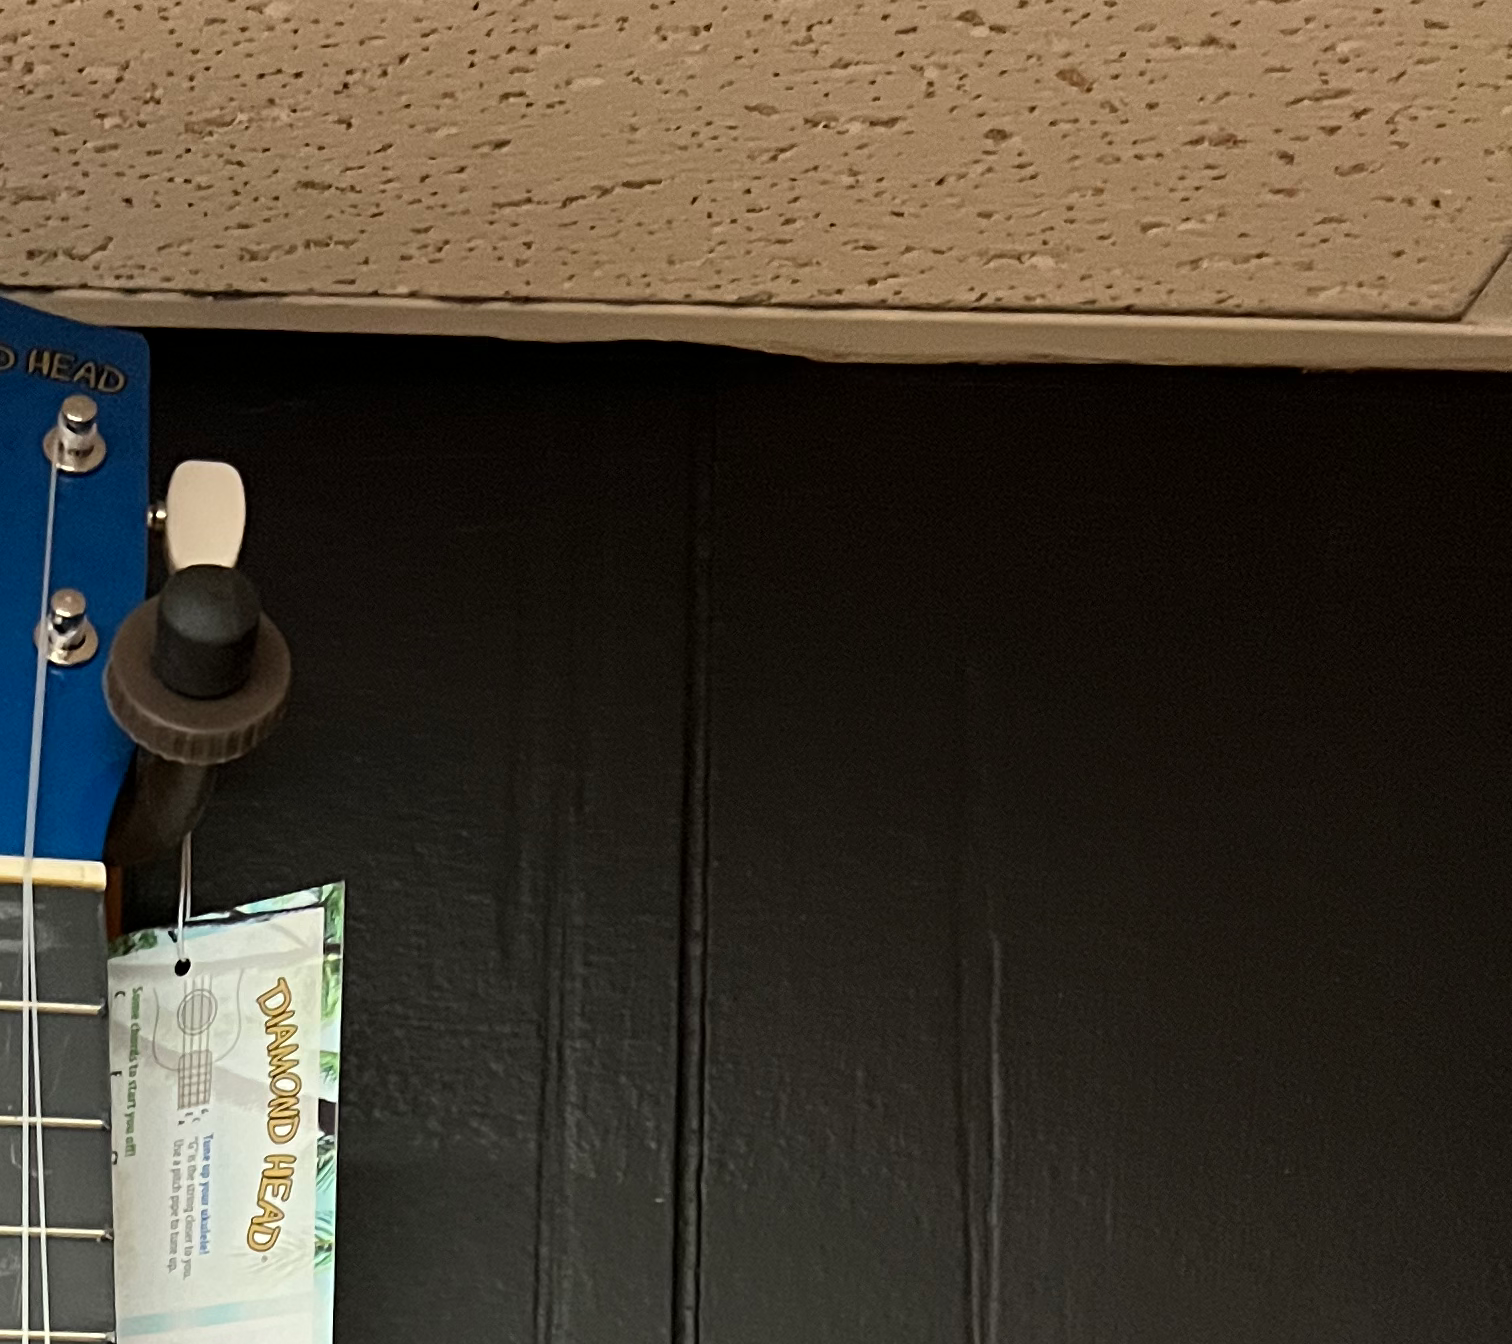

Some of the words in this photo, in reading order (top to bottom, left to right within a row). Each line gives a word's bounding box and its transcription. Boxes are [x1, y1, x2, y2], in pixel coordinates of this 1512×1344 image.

[27, 348, 127, 394] HEAD
[257, 976, 302, 1144] DIAMOND
[246, 1154, 297, 1252] HEAD
